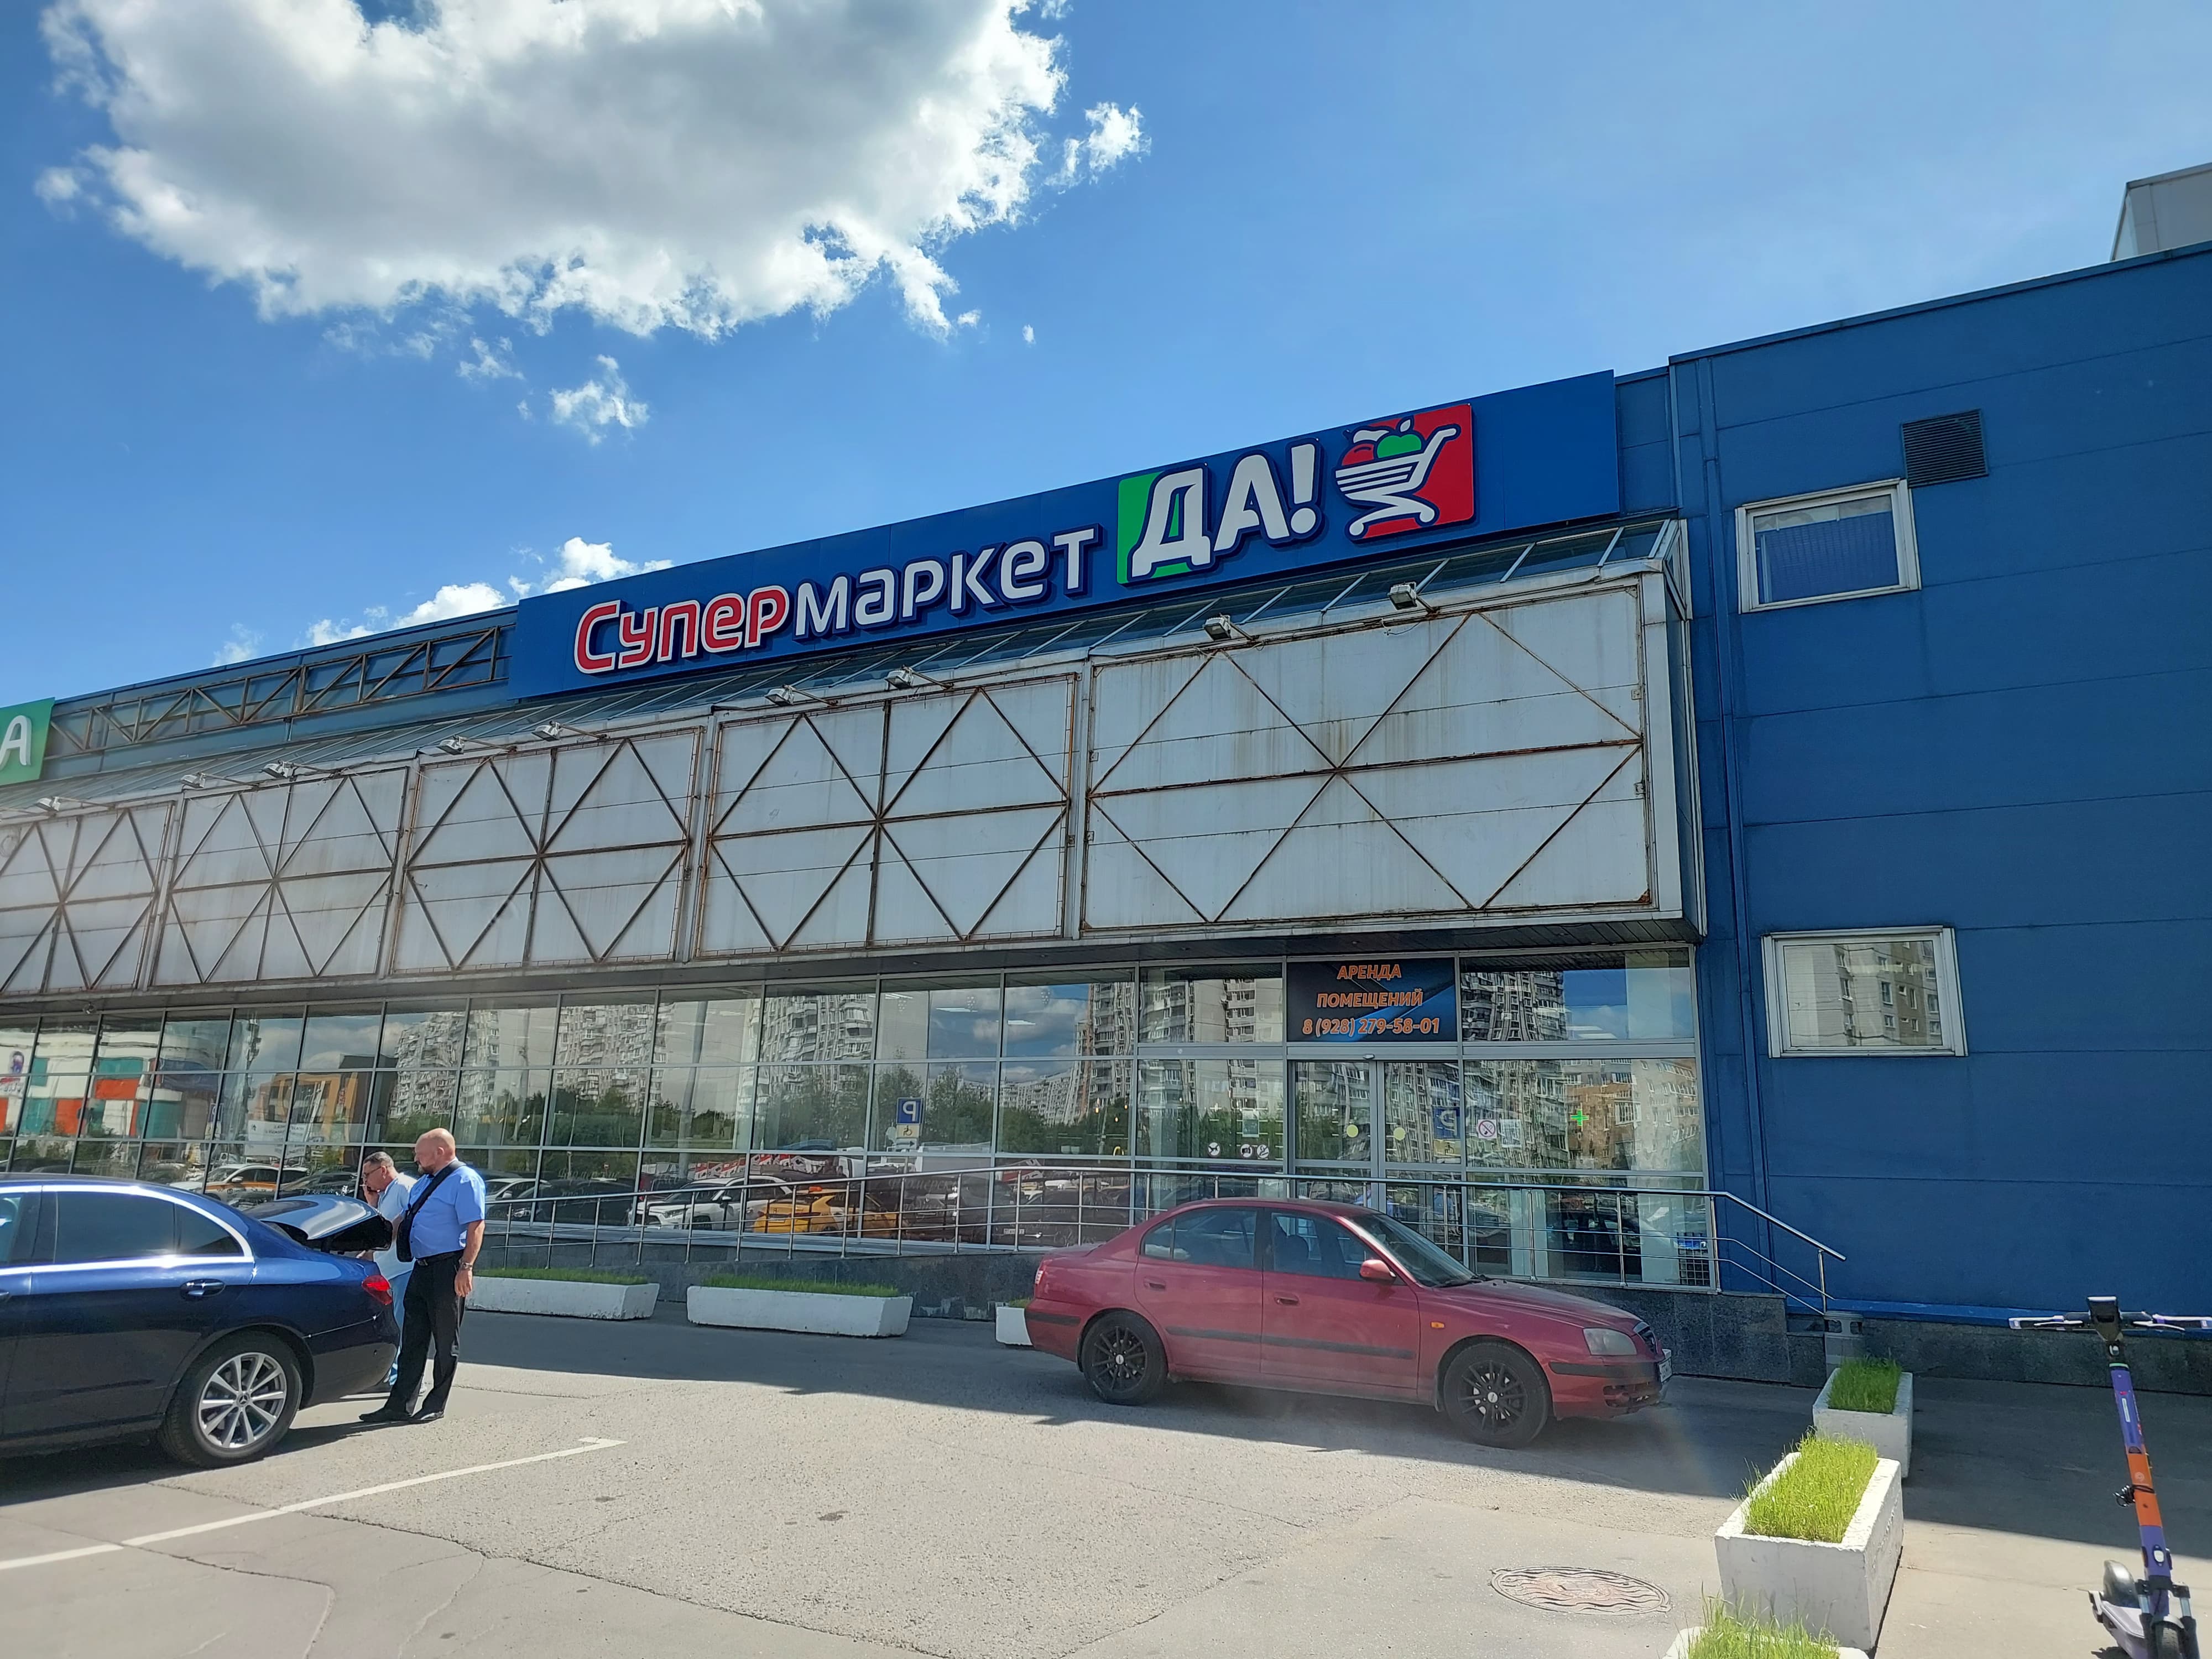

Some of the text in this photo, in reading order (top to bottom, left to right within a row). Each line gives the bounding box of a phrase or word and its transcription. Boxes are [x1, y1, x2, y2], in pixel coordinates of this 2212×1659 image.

[573, 442, 1318, 675] Супермаркет ДА!
[1337, 964, 1402, 980] АРЕНДА
[1316, 988, 1424, 1009] ПОМЕЩЕНИЙ
[1302, 1018, 1440, 1037] 8 (928) 279-58-01
